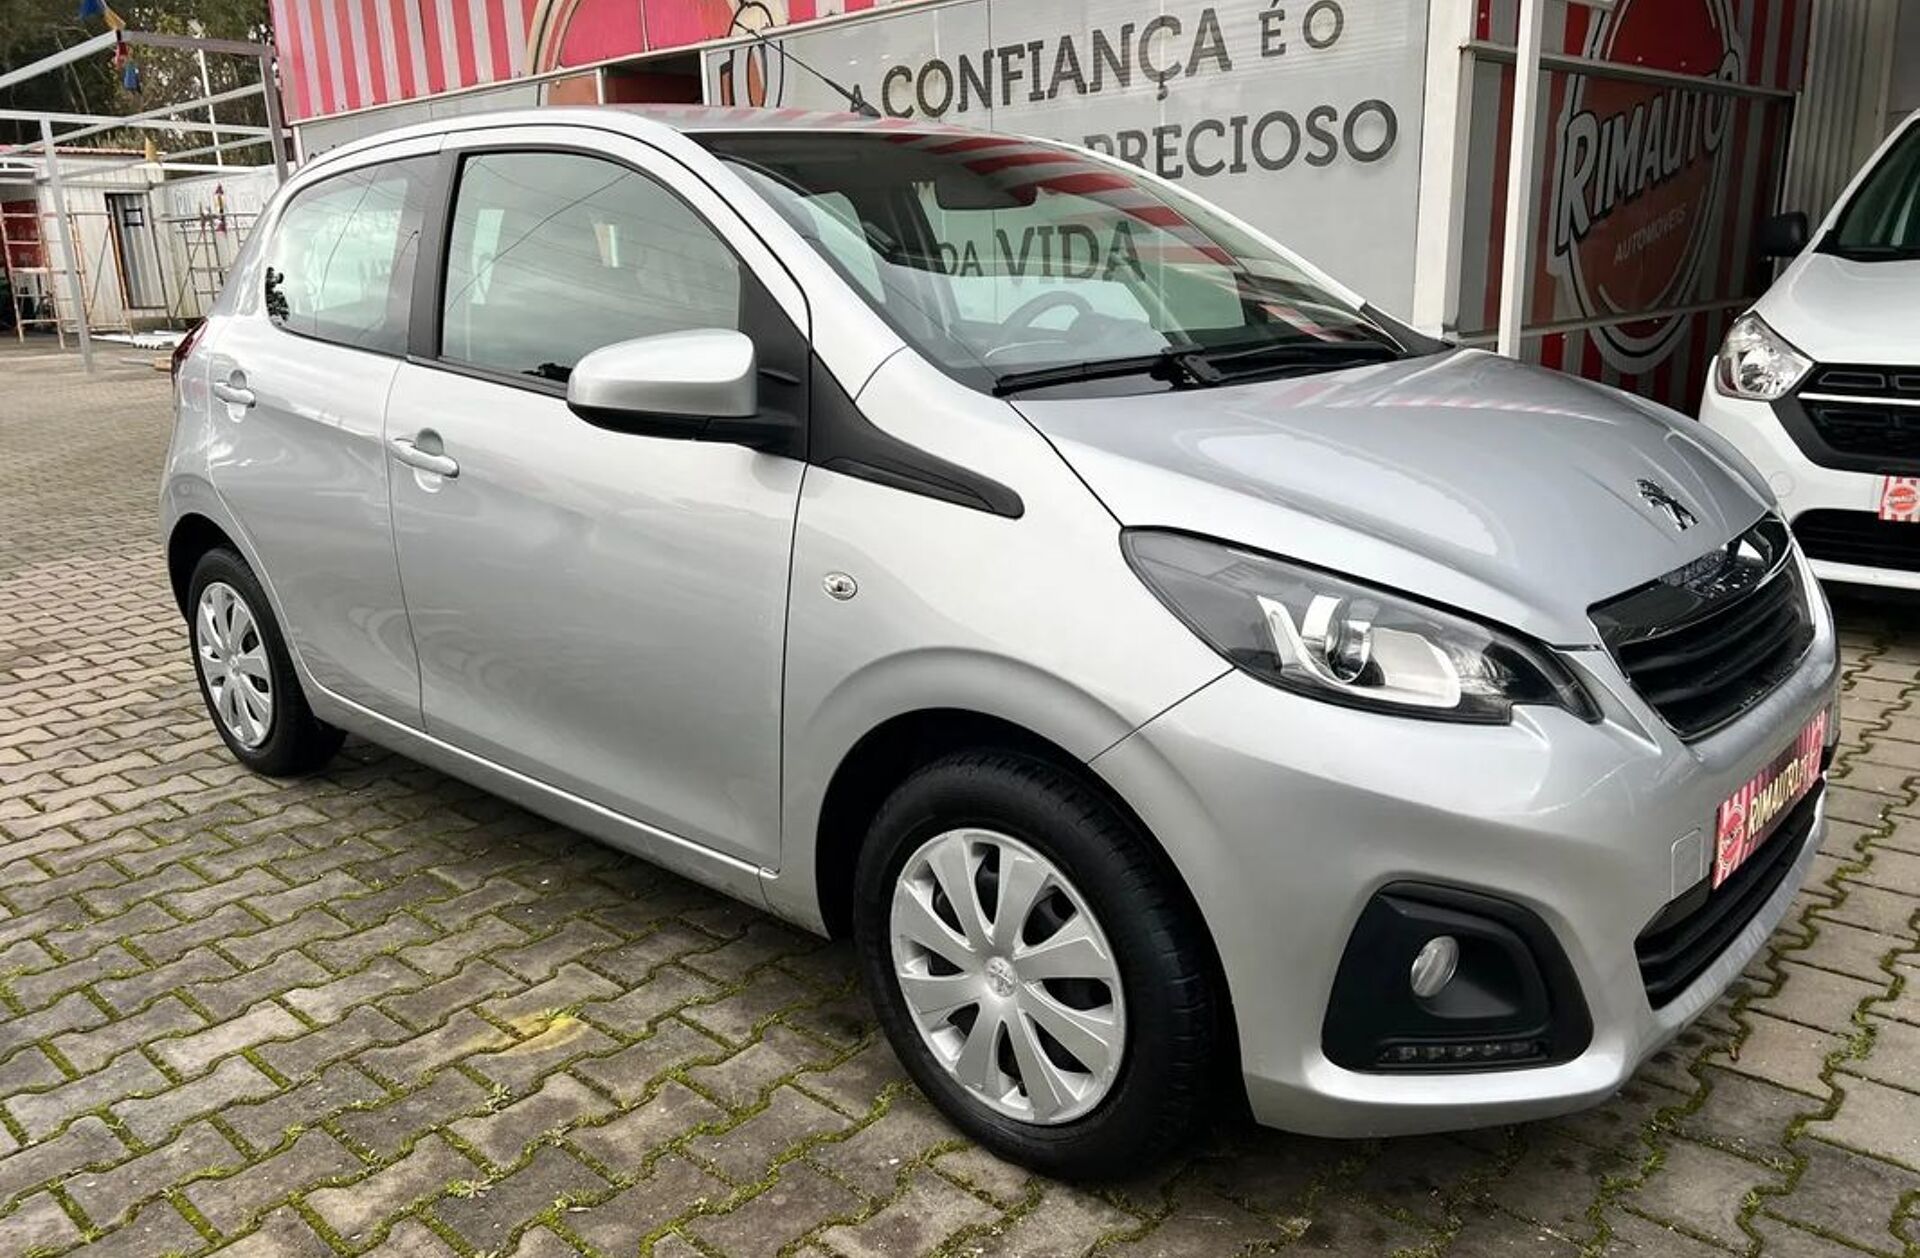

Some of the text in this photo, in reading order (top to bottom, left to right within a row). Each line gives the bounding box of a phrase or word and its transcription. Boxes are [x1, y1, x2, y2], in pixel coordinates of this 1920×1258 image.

[881, 8, 1232, 119] CONFIANÇA
[1258, 0, 1286, 57] É
[1302, 0, 1344, 49] O
[1555, 52, 1740, 255] RIMAUTO
[996, 220, 1146, 287] VIDA
